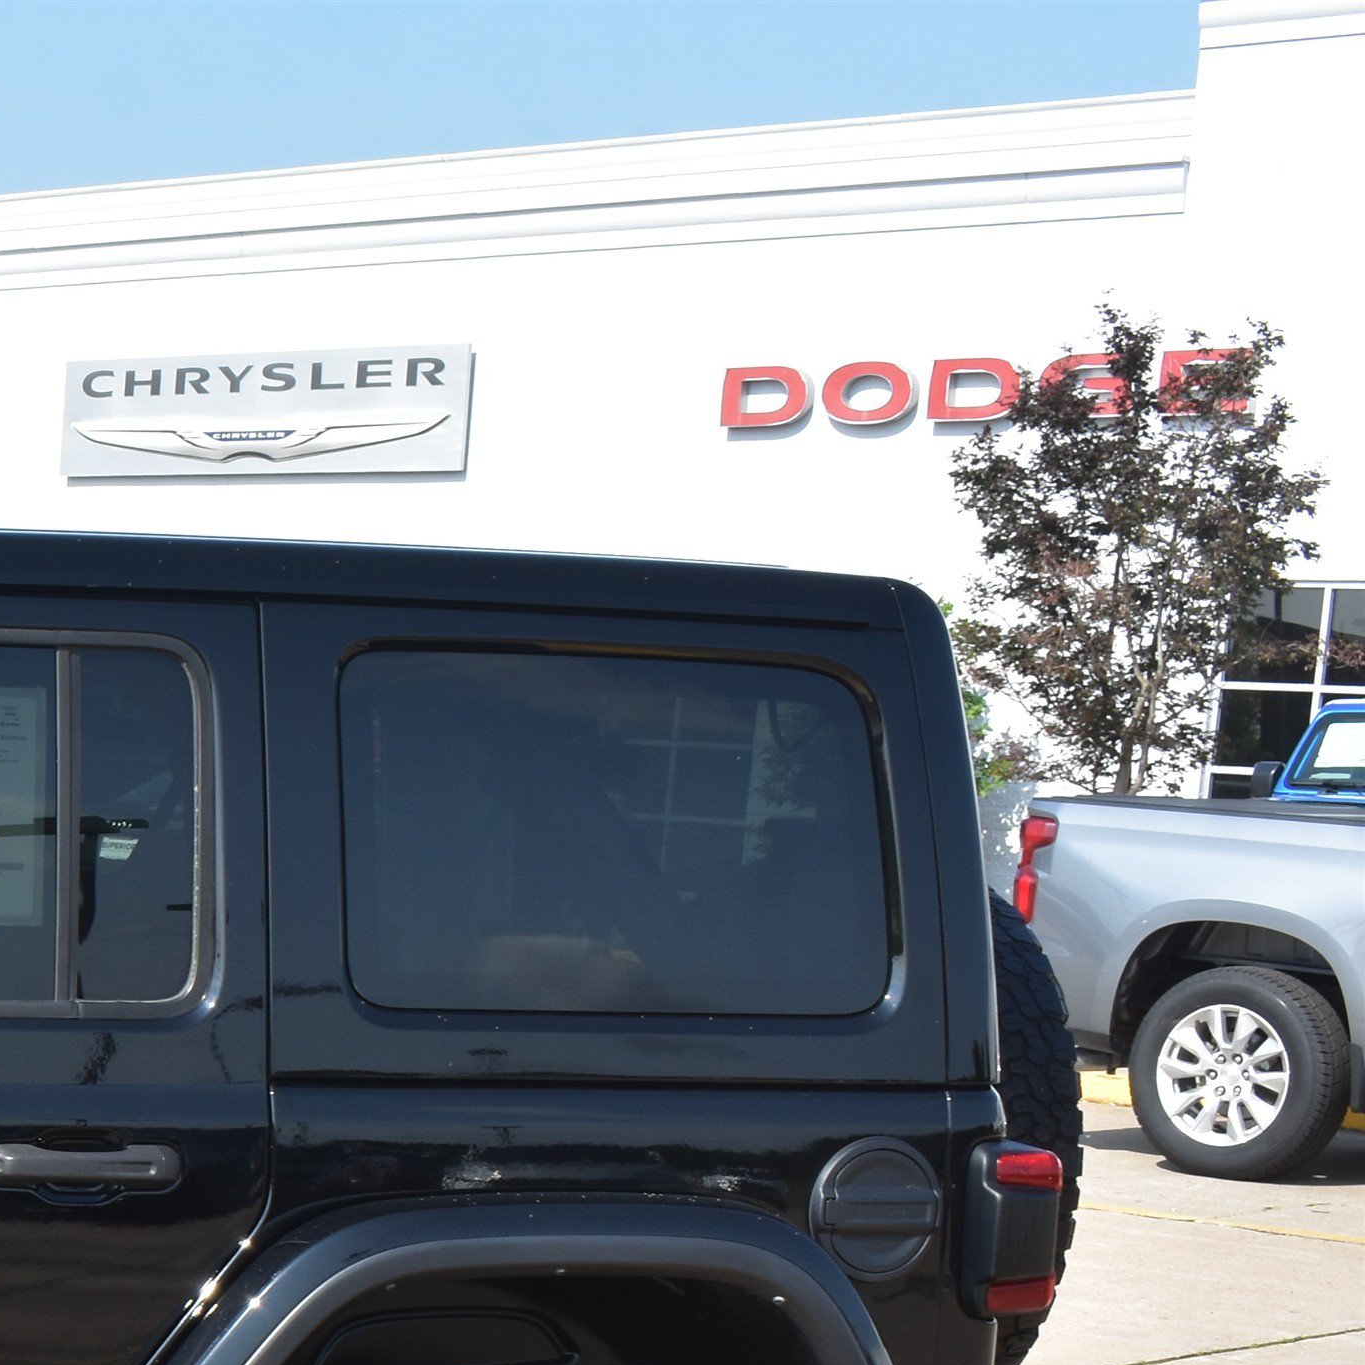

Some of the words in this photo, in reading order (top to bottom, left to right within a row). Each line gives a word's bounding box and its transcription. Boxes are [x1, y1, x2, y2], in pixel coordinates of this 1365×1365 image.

[81, 357, 447, 398] CHRYSLER
[720, 348, 1255, 427] DODGE
[212, 431, 287, 441] CHRYSLER
